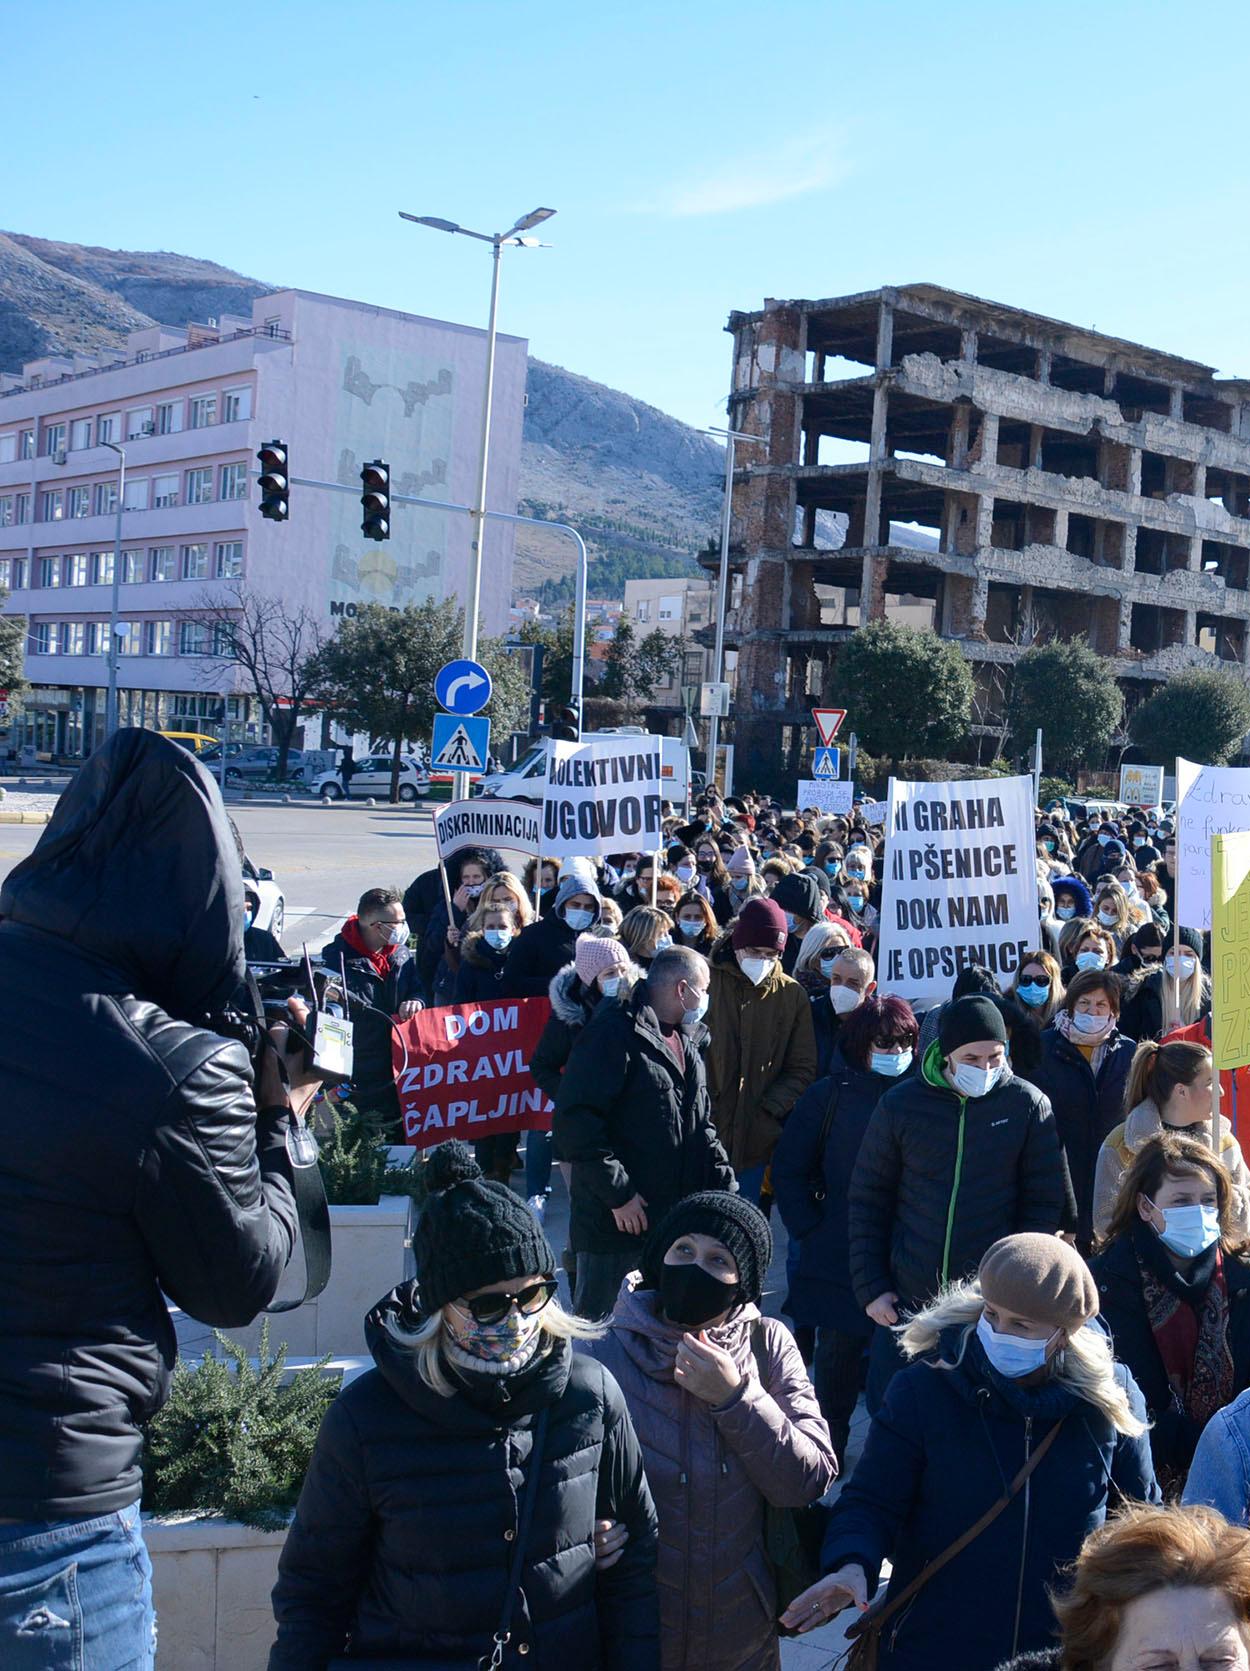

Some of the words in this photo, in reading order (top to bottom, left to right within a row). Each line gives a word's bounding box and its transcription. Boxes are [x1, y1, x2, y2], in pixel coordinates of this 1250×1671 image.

[438, 812, 539, 845] DISKRIMINACIJA
[544, 794, 661, 840] UGOVOR
[913, 797, 1005, 832] GRAHA
[909, 843, 1018, 881] PŠENICE
[896, 898, 943, 931] DOK
[947, 893, 1009, 928] NAM
[445, 1006, 519, 1041] DOM
[401, 1049, 530, 1095] ZDRAVL
